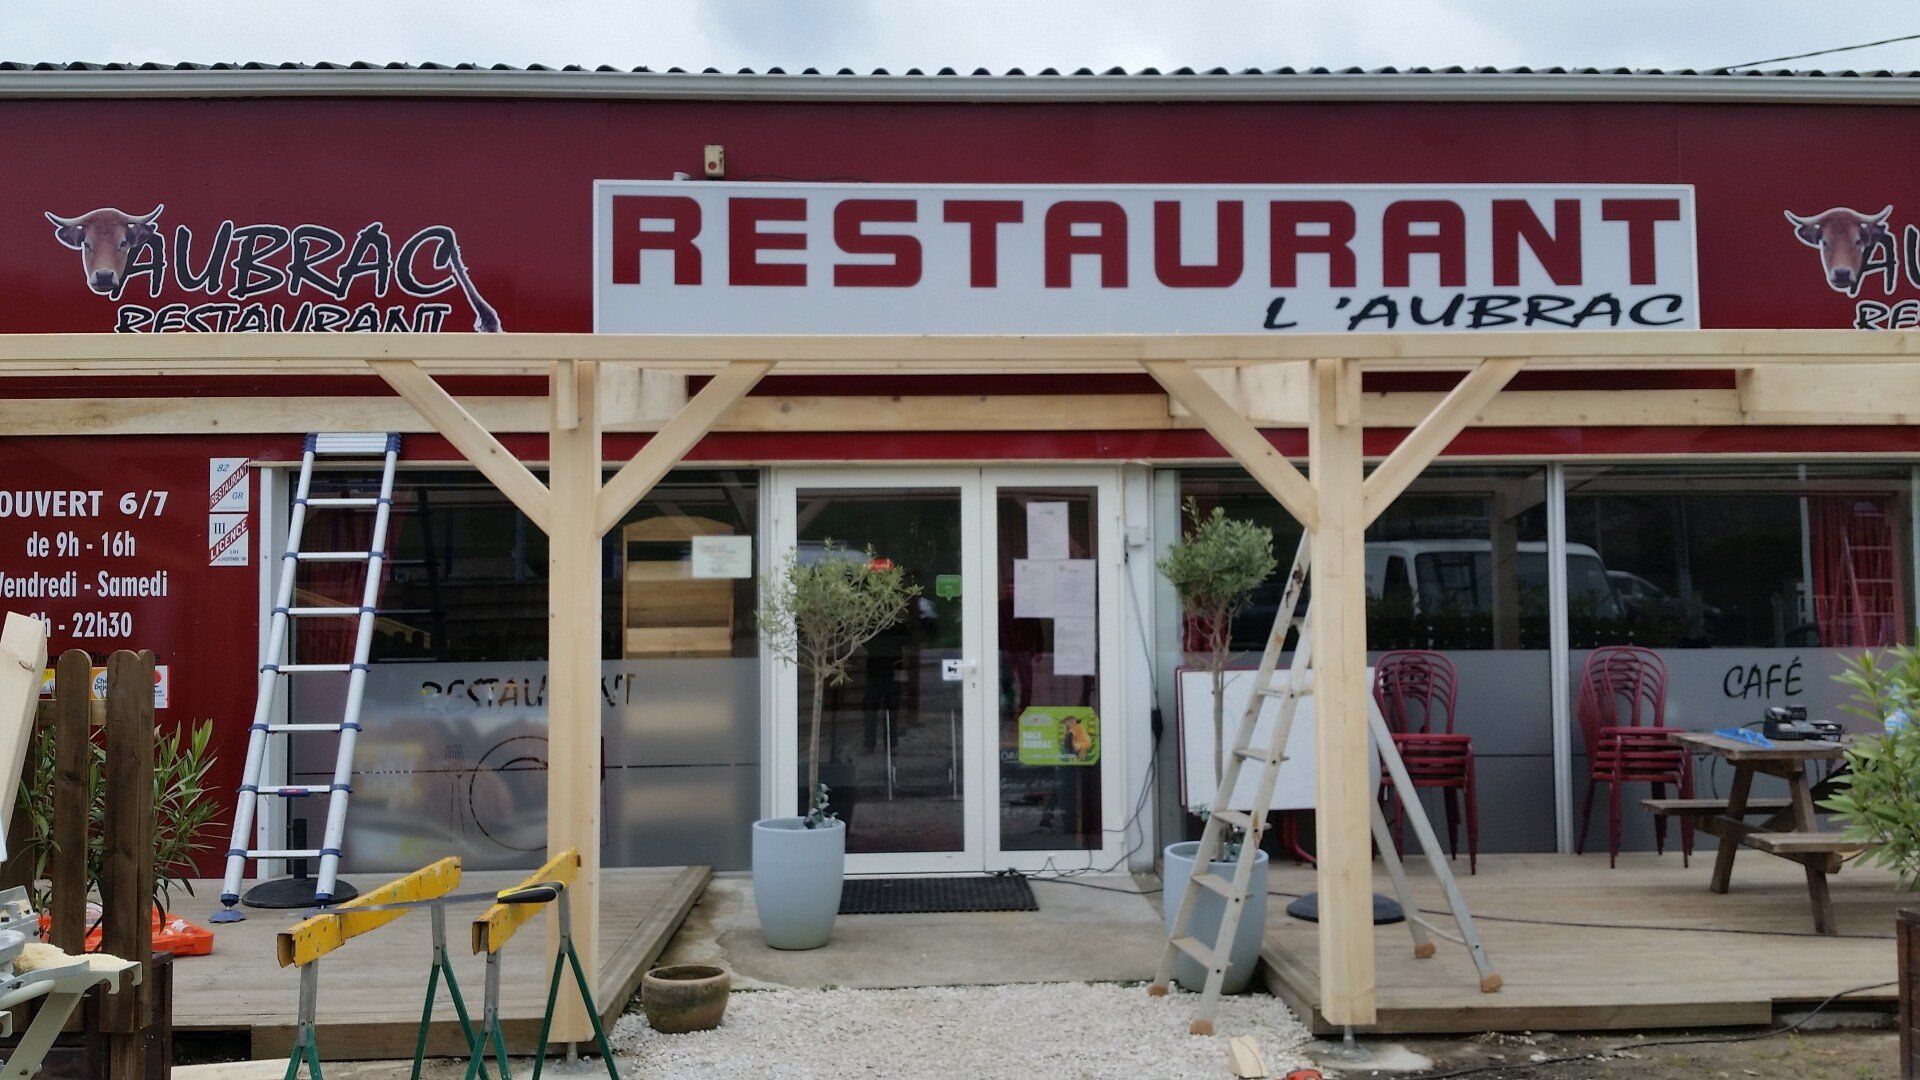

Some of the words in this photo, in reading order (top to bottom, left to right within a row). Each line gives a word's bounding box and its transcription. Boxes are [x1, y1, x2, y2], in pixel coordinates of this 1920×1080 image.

[612, 194, 1681, 288] RESTAURANT
[110, 220, 457, 300] AUBRAC
[115, 301, 452, 334] RESTAURANT
[217, 463, 229, 472] 82
[210, 461, 248, 507] RESTAURANT
[231, 491, 244, 500] GR
[0, 490, 103, 517] OUVERT
[119, 490, 168, 519] 6/7
[210, 519, 247, 561] LICENCE
[213, 522, 226, 534] III
[27, 531, 49, 557] de
[56, 531, 79, 557] 9h
[102, 531, 136, 557] 16h
[97, 571, 168, 597] Samedi
[72, 612, 132, 638] 22h30
[1723, 655, 1803, 700] CAFÉ
